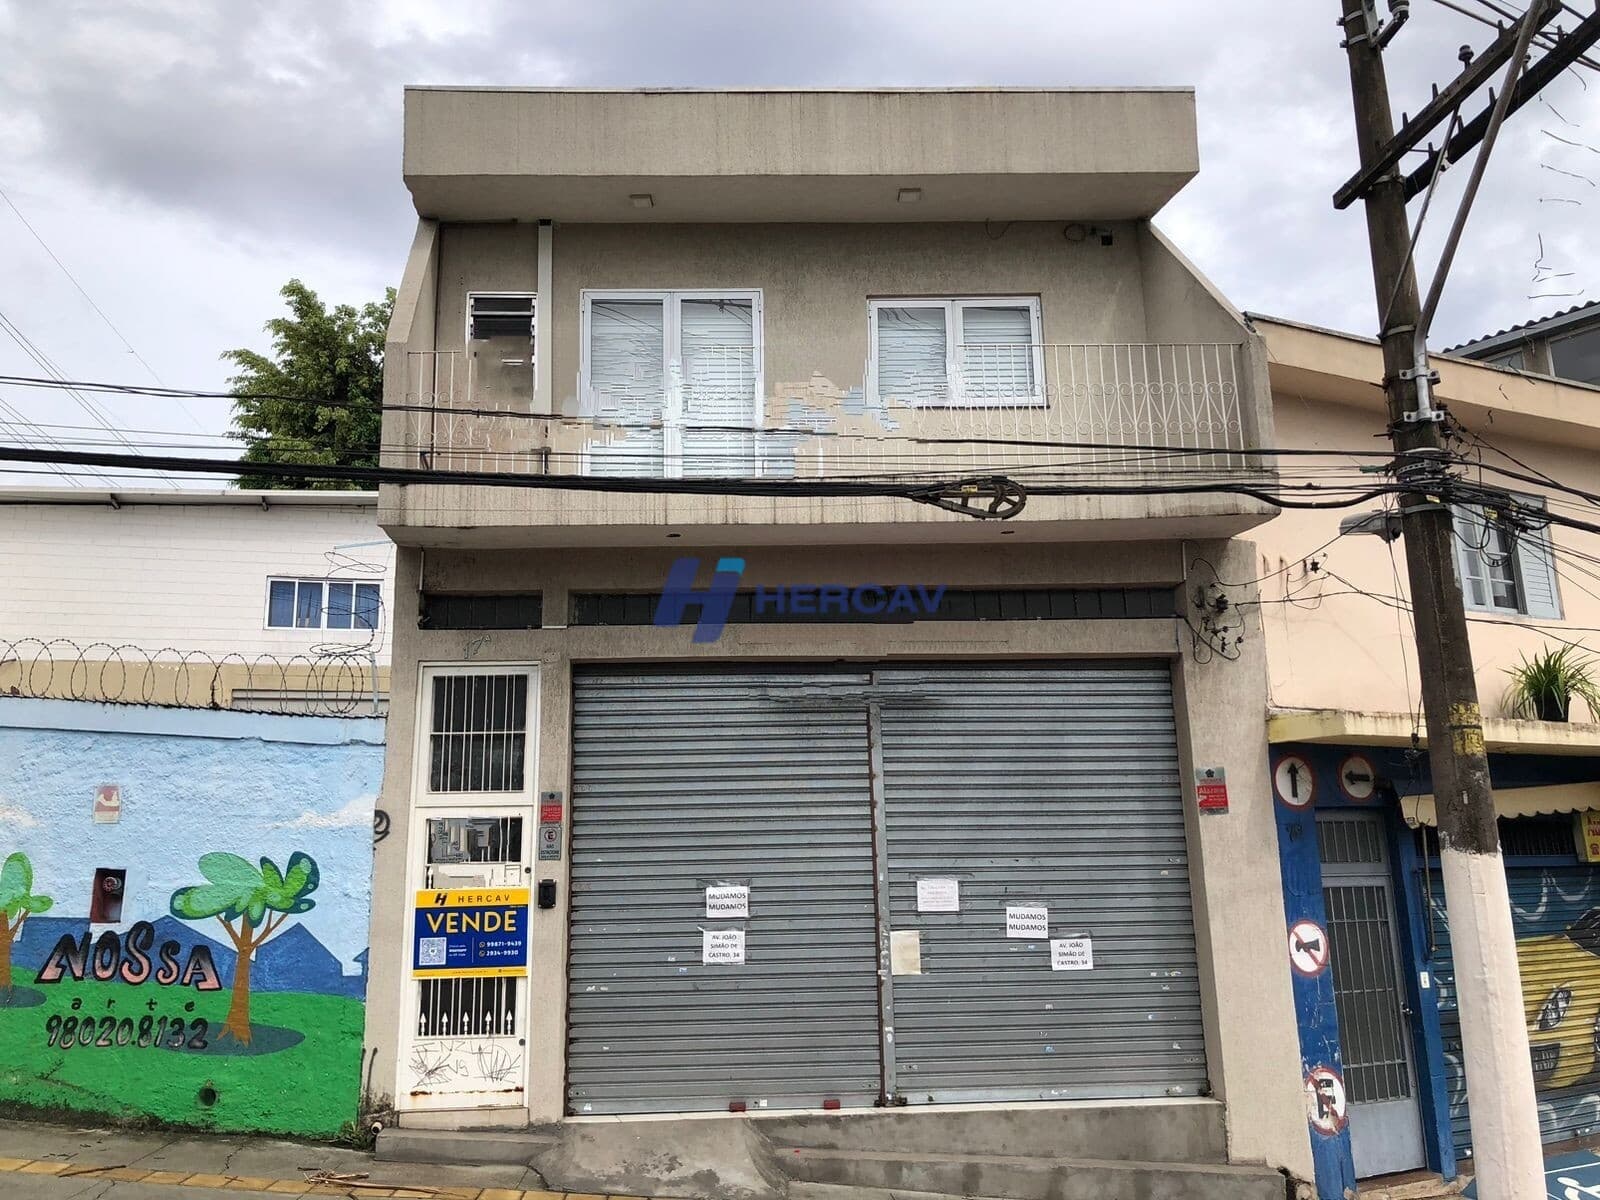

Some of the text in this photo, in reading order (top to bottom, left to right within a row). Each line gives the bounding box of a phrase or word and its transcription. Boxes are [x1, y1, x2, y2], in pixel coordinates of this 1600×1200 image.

[457, 894, 510, 903] HERCAV
[708, 892, 746, 900] MUDAMOS
[426, 910, 517, 933] VENDE
[1008, 912, 1046, 920] MUDAMOS
[34, 920, 223, 991] NOSSA
[45, 1014, 209, 1050] 98020.8132
